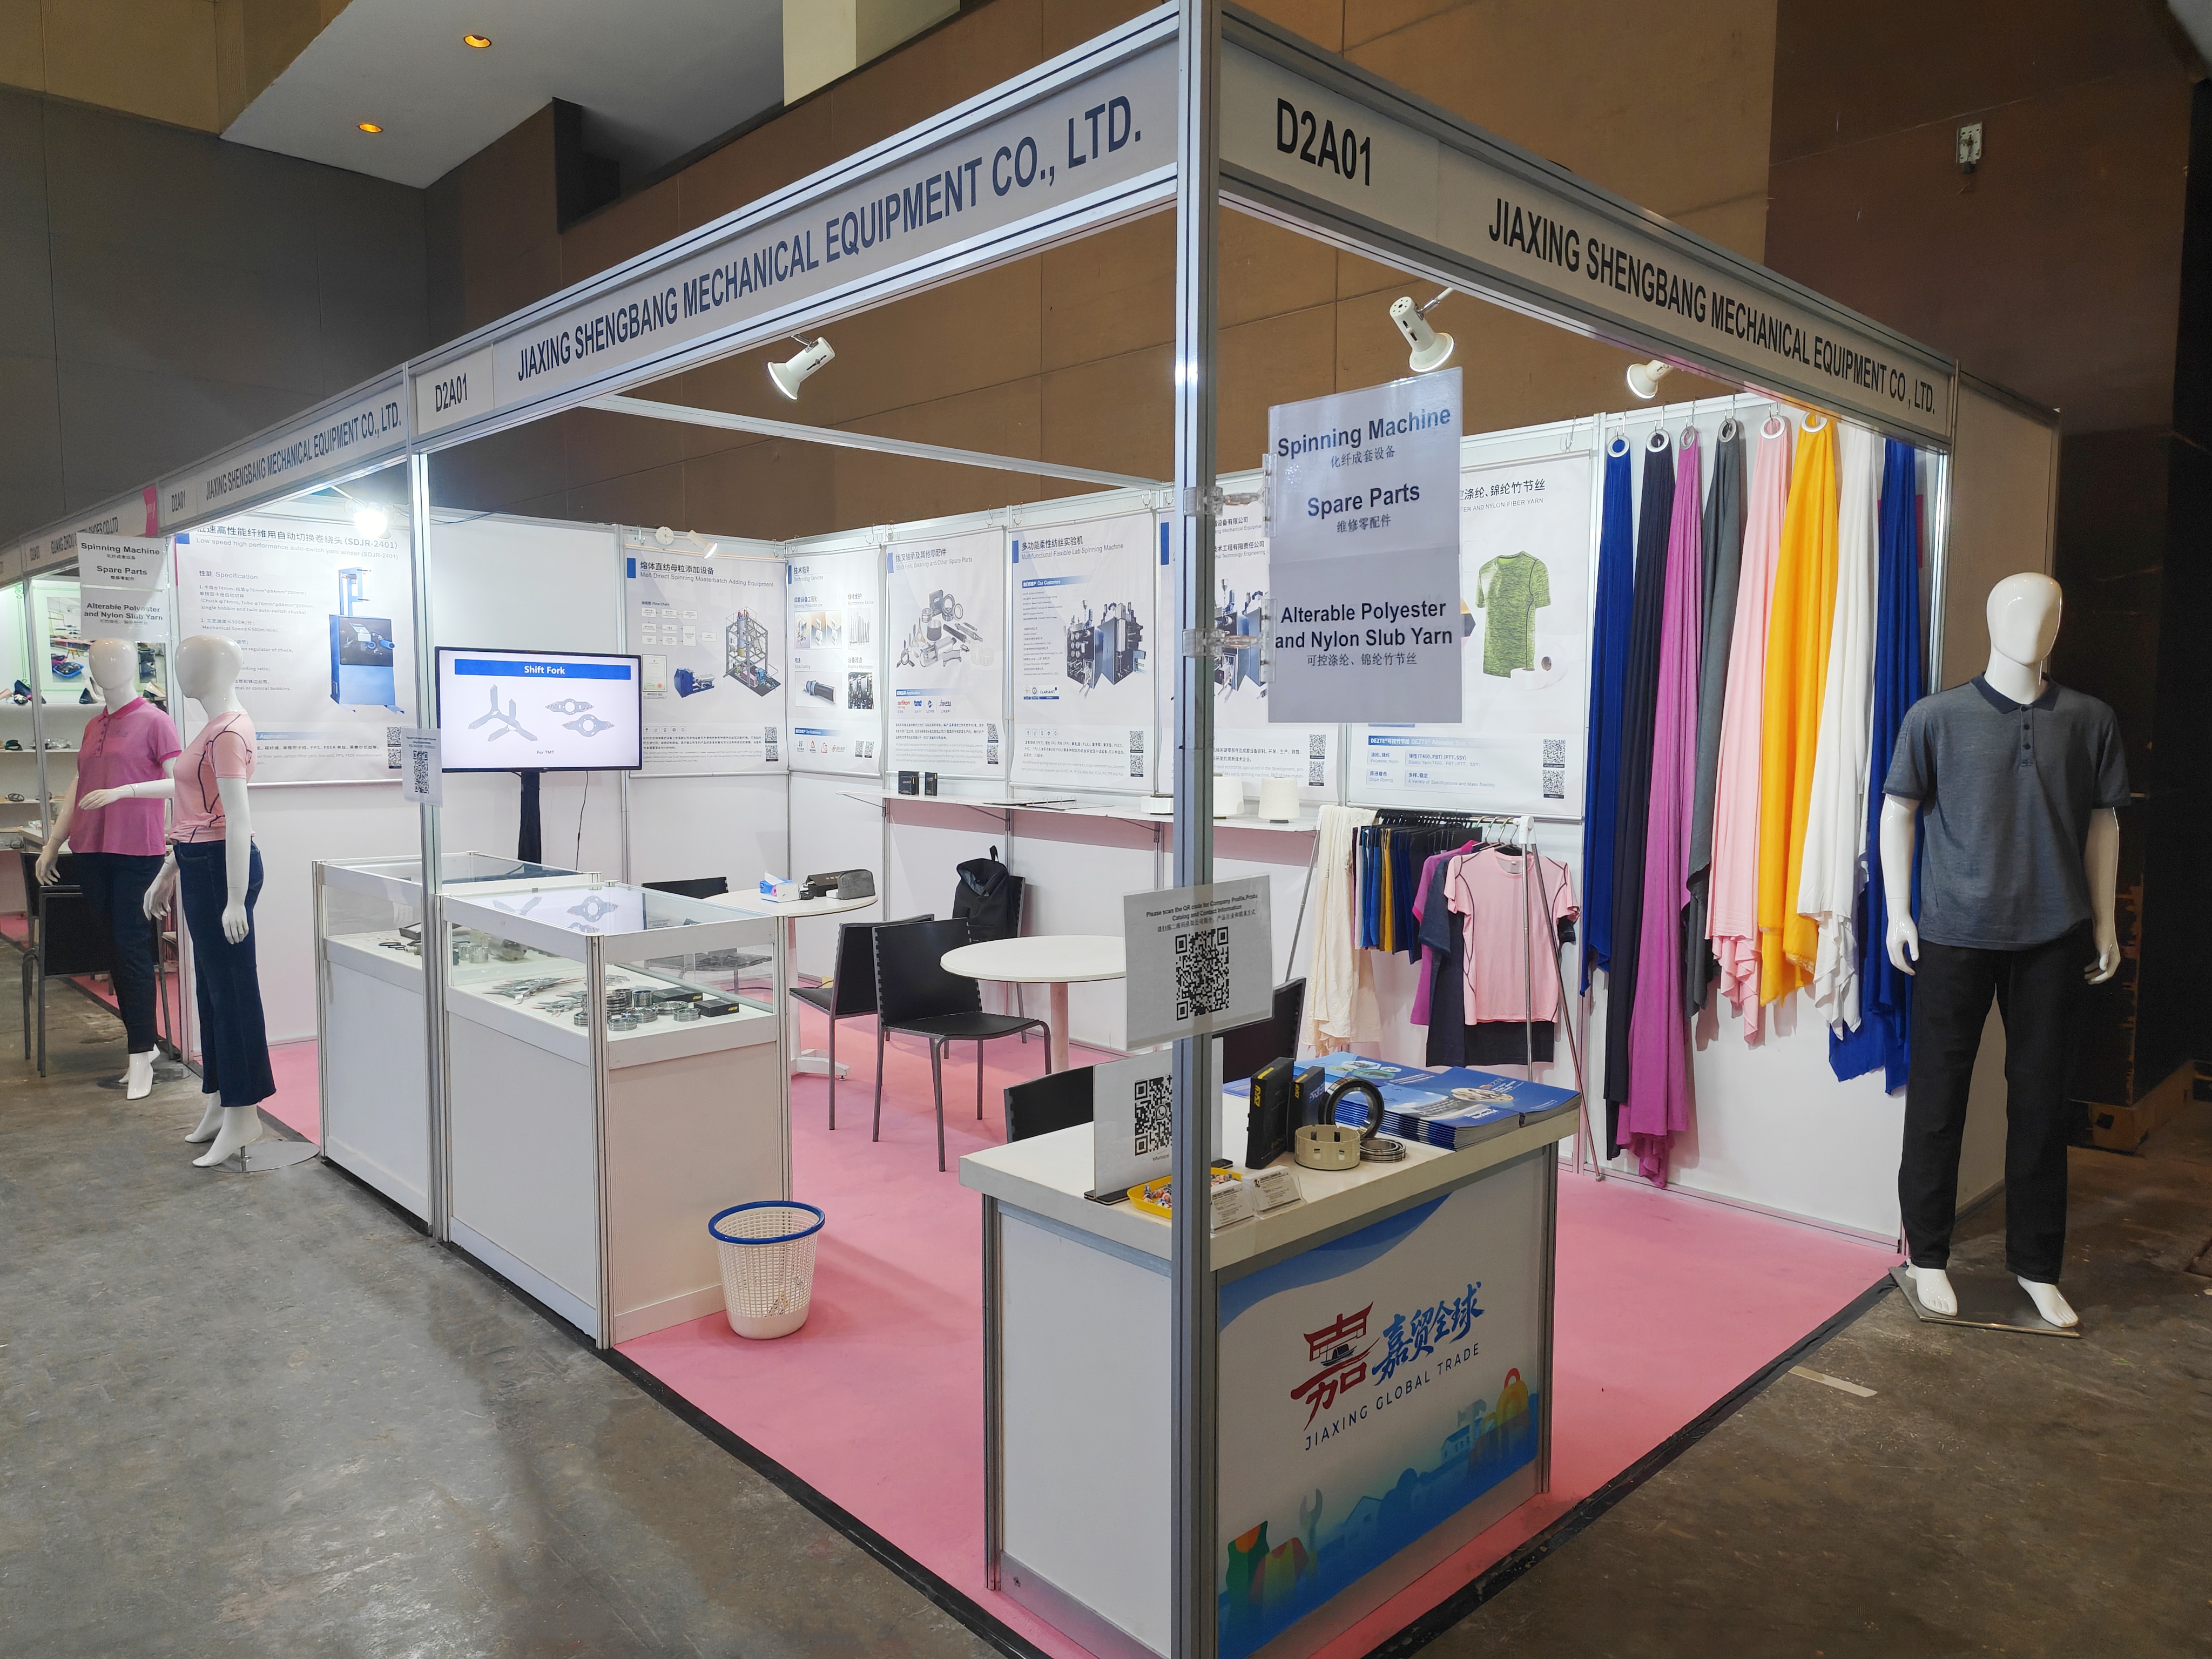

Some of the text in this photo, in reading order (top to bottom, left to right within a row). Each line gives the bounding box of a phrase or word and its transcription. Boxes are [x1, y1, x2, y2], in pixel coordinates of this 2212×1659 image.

[1277, 98, 1370, 186] D2A01
[518, 96, 1141, 381] JIAXING SHENGBANG MECHANICAL EQUIPMENT CO., LTD.
[1489, 198, 1935, 414] JIAXING SHENGBANG MECHANICAL EQUIPMENT LTD.
[435, 373, 468, 412] D2A01
[1278, 406, 1451, 458] Spinning Machine
[206, 402, 401, 500] JIAXING SHENGBANG MECHANICAL EQUIPMENT CO., LTD.
[1331, 446, 1395, 468] 化纤成套设备
[171, 491, 186, 512] D2A01
[1308, 483, 1420, 519] Spare Parts
[1337, 514, 1391, 533] 维修零配件
[81, 543, 160, 555] Spinning Machine
[249, 542, 288, 550] performance
[361, 551, 398, 560] (SDJR-2401)
[1082, 546, 1102, 554] Spinning
[97, 565, 147, 575] Spare Parts
[215, 571, 258, 579] Specification
[671, 574, 694, 582] Spinning
[695, 576, 727, 584] Masterbatch
[729, 578, 746, 586] Adding
[101, 611, 124, 619] Nylon
[1281, 601, 1446, 625] Alterable Polyester
[1276, 626, 1453, 651] and Nylon Slub Yarn
[524, 665, 565, 675] Shift Fork
[1307, 653, 1418, 667] 可控涤纶、锦纶竹节丝
[1305, 1343, 1480, 1451] JIAXING GLOBAL TRADE
